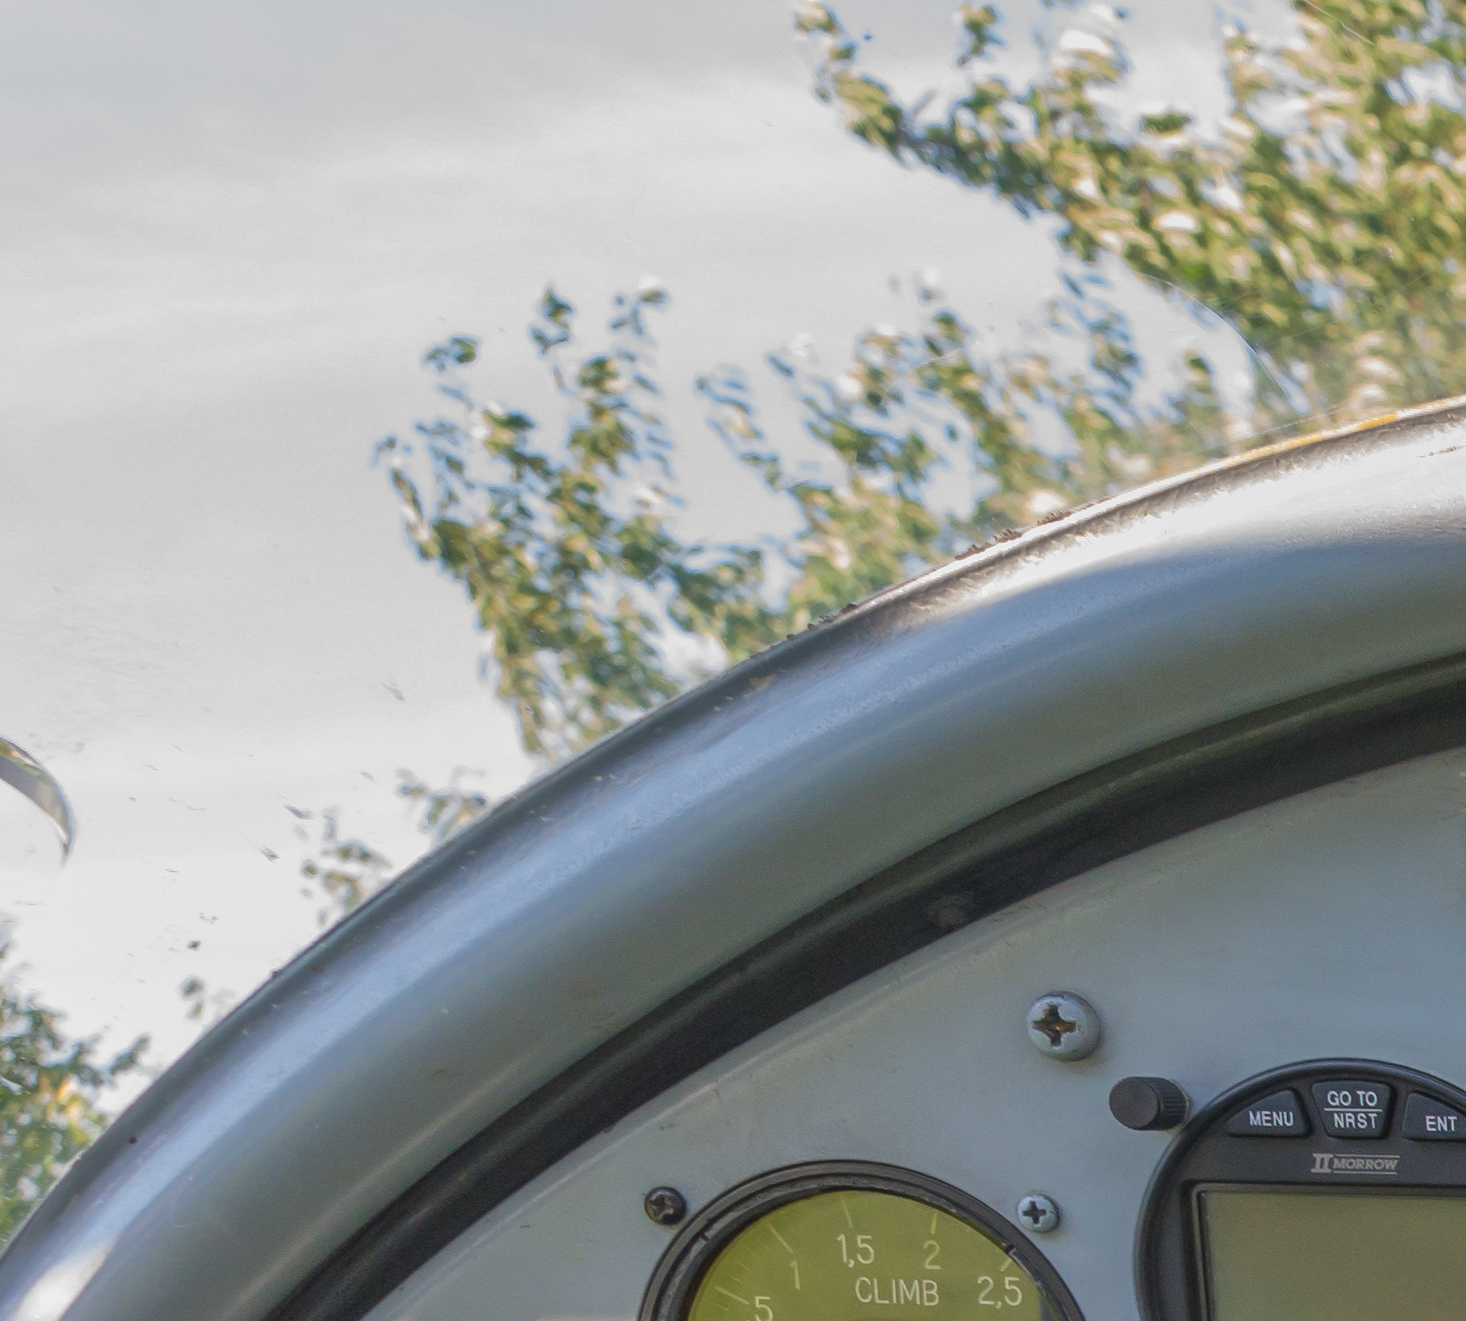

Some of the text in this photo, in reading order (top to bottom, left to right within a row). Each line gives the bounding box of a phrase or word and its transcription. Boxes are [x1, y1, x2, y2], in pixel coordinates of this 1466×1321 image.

[1249, 1111, 1294, 1127] MENU
[1333, 1113, 1378, 1129] NRST
[1425, 1116, 1457, 1132] ENT
[856, 1279, 940, 1306] CLIMB
